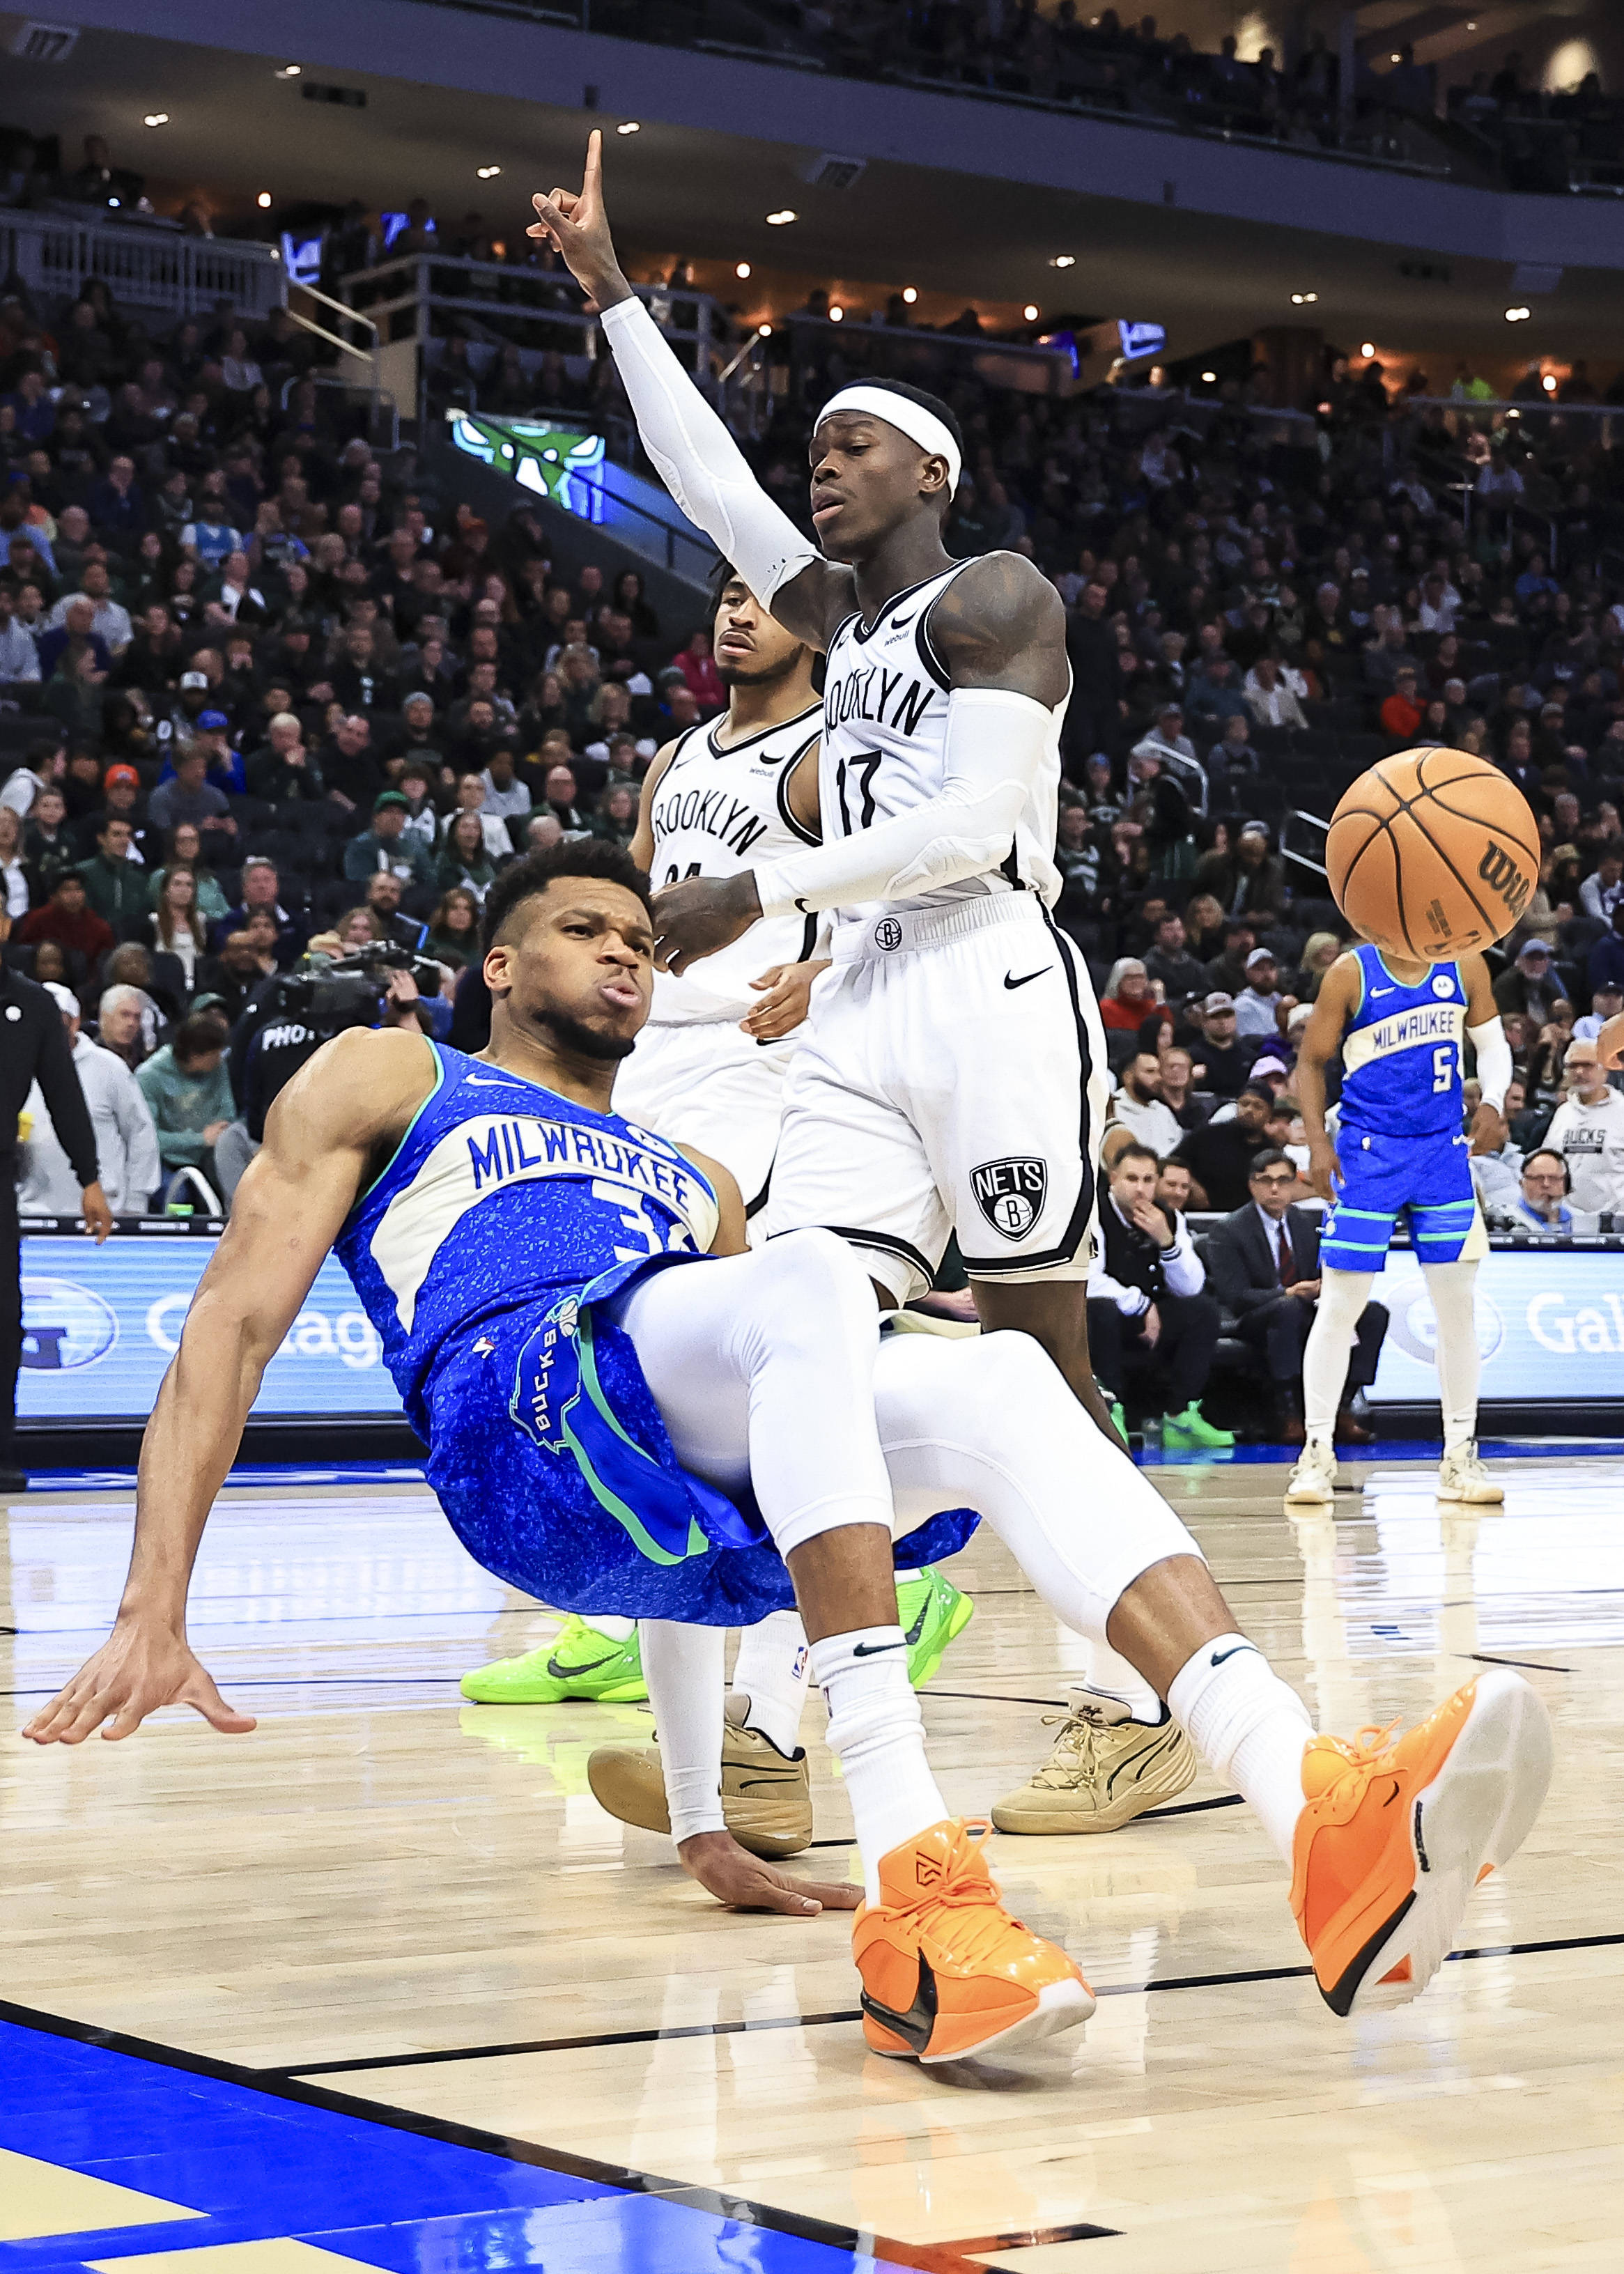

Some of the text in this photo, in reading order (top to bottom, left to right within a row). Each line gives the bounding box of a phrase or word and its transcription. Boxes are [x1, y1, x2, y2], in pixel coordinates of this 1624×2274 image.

[654, 789, 768, 857] ROOKLYN
[836, 749, 883, 837] 17
[1373, 1011, 1455, 1053] MILWAUKEE
[1432, 1046, 1452, 1094] 5
[467, 1122, 690, 1212] MILWAUKEE
[975, 1162, 1043, 1200] NETS
[532, 1329, 557, 1431] BUCKS
